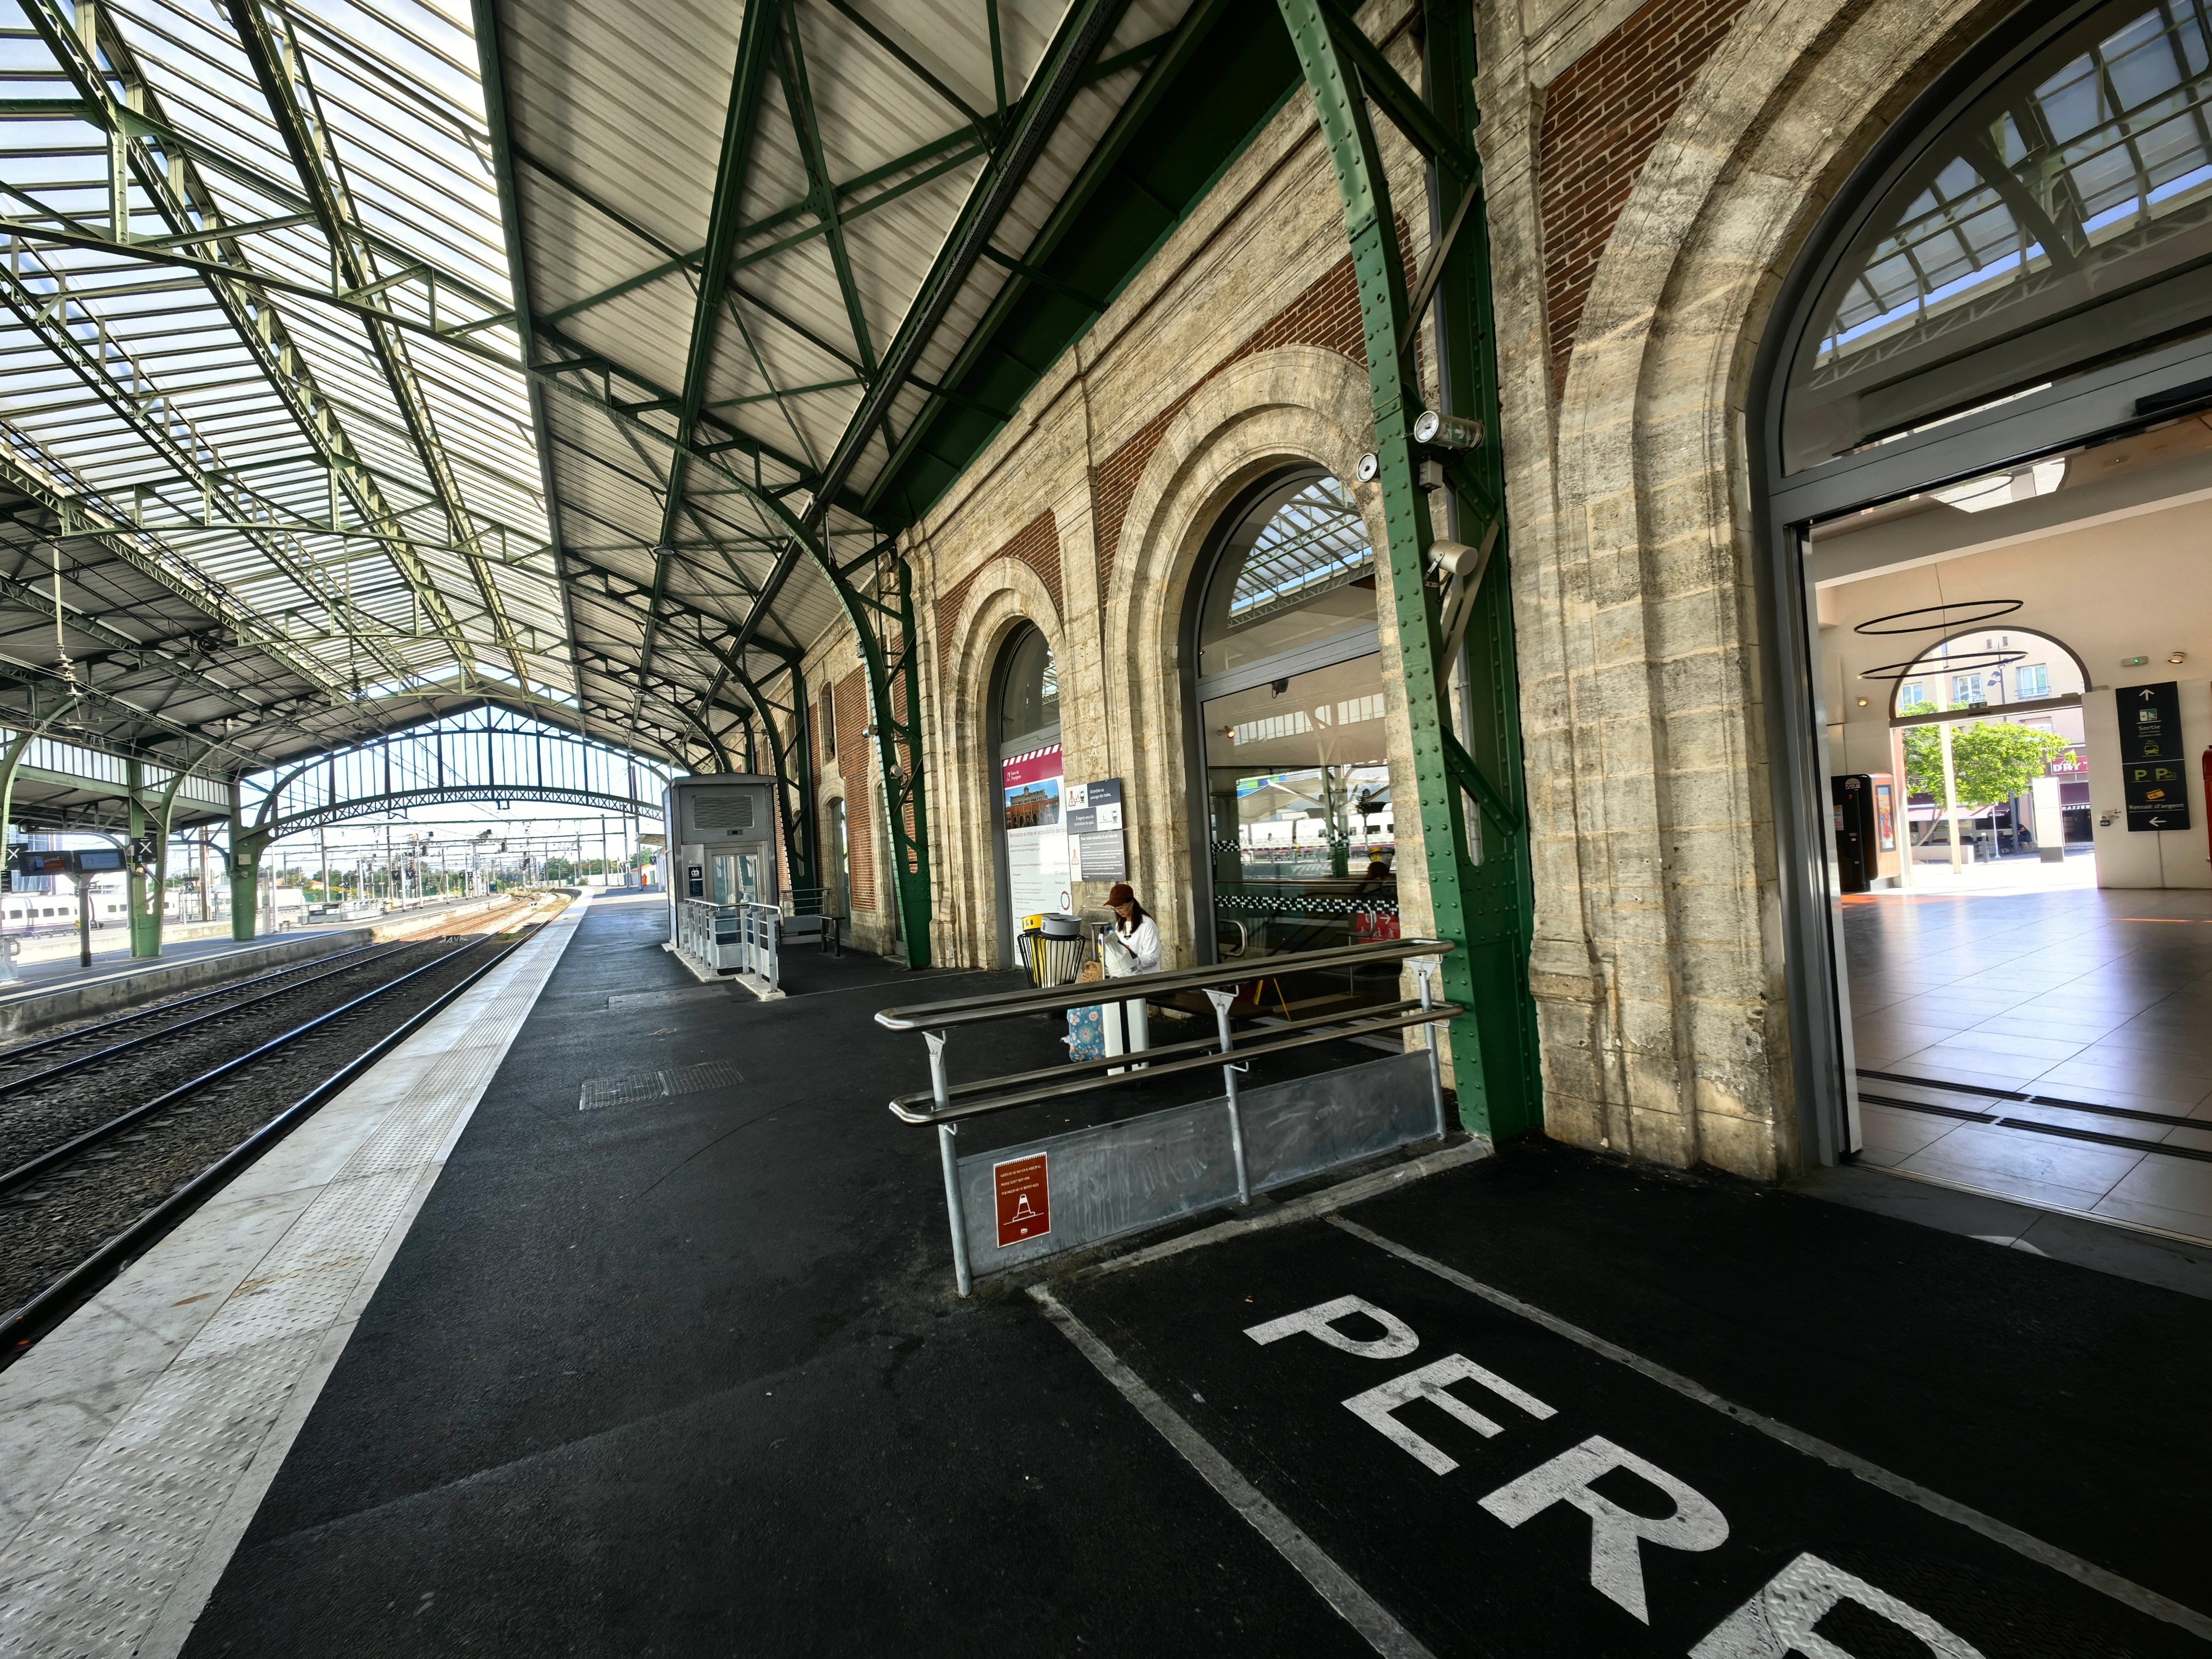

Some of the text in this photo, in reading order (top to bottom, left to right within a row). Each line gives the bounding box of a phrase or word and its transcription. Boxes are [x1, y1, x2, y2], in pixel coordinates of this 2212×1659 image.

[2135, 768, 2168, 781] P P
[6, 848, 20, 860] X
[138, 841, 153, 854] X
